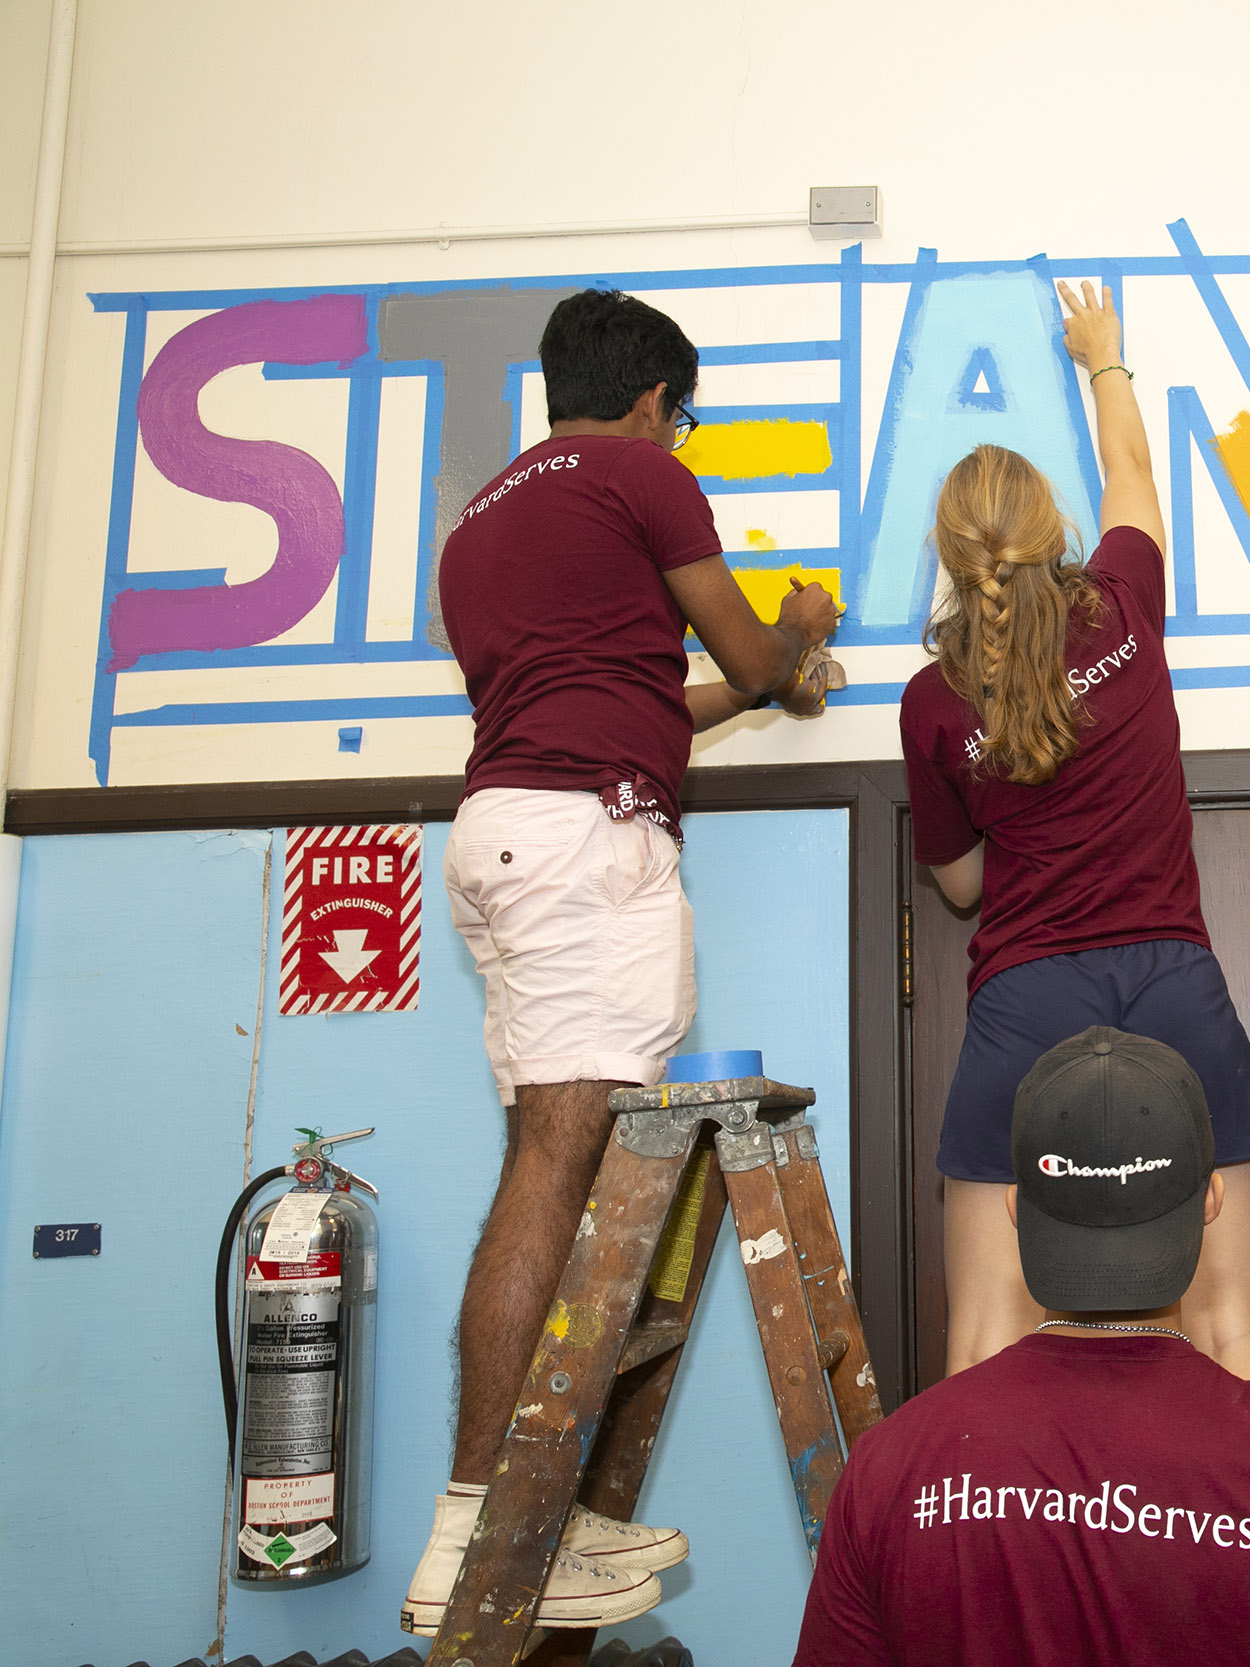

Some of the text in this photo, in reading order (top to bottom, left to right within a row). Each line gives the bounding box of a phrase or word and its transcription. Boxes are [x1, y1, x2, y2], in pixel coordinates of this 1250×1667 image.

[452, 453, 580, 532] arvardServes
[311, 855, 394, 886] FIRE
[309, 898, 394, 921] EXTINGUISHER
[1038, 1154, 1172, 1185] Champion
[55, 1228, 79, 1242] 317
[264, 1313, 317, 1323] ALLENCO
[303, 1344, 336, 1352] UPRIGHT
[276, 1355, 308, 1363] SQUEEZE
[310, 1352, 333, 1361] LEVER
[264, 1480, 312, 1489] PROPERTY
[269, 1501, 290, 1509] SCHOOL
[293, 1496, 330, 1507] DEPARTMENT
